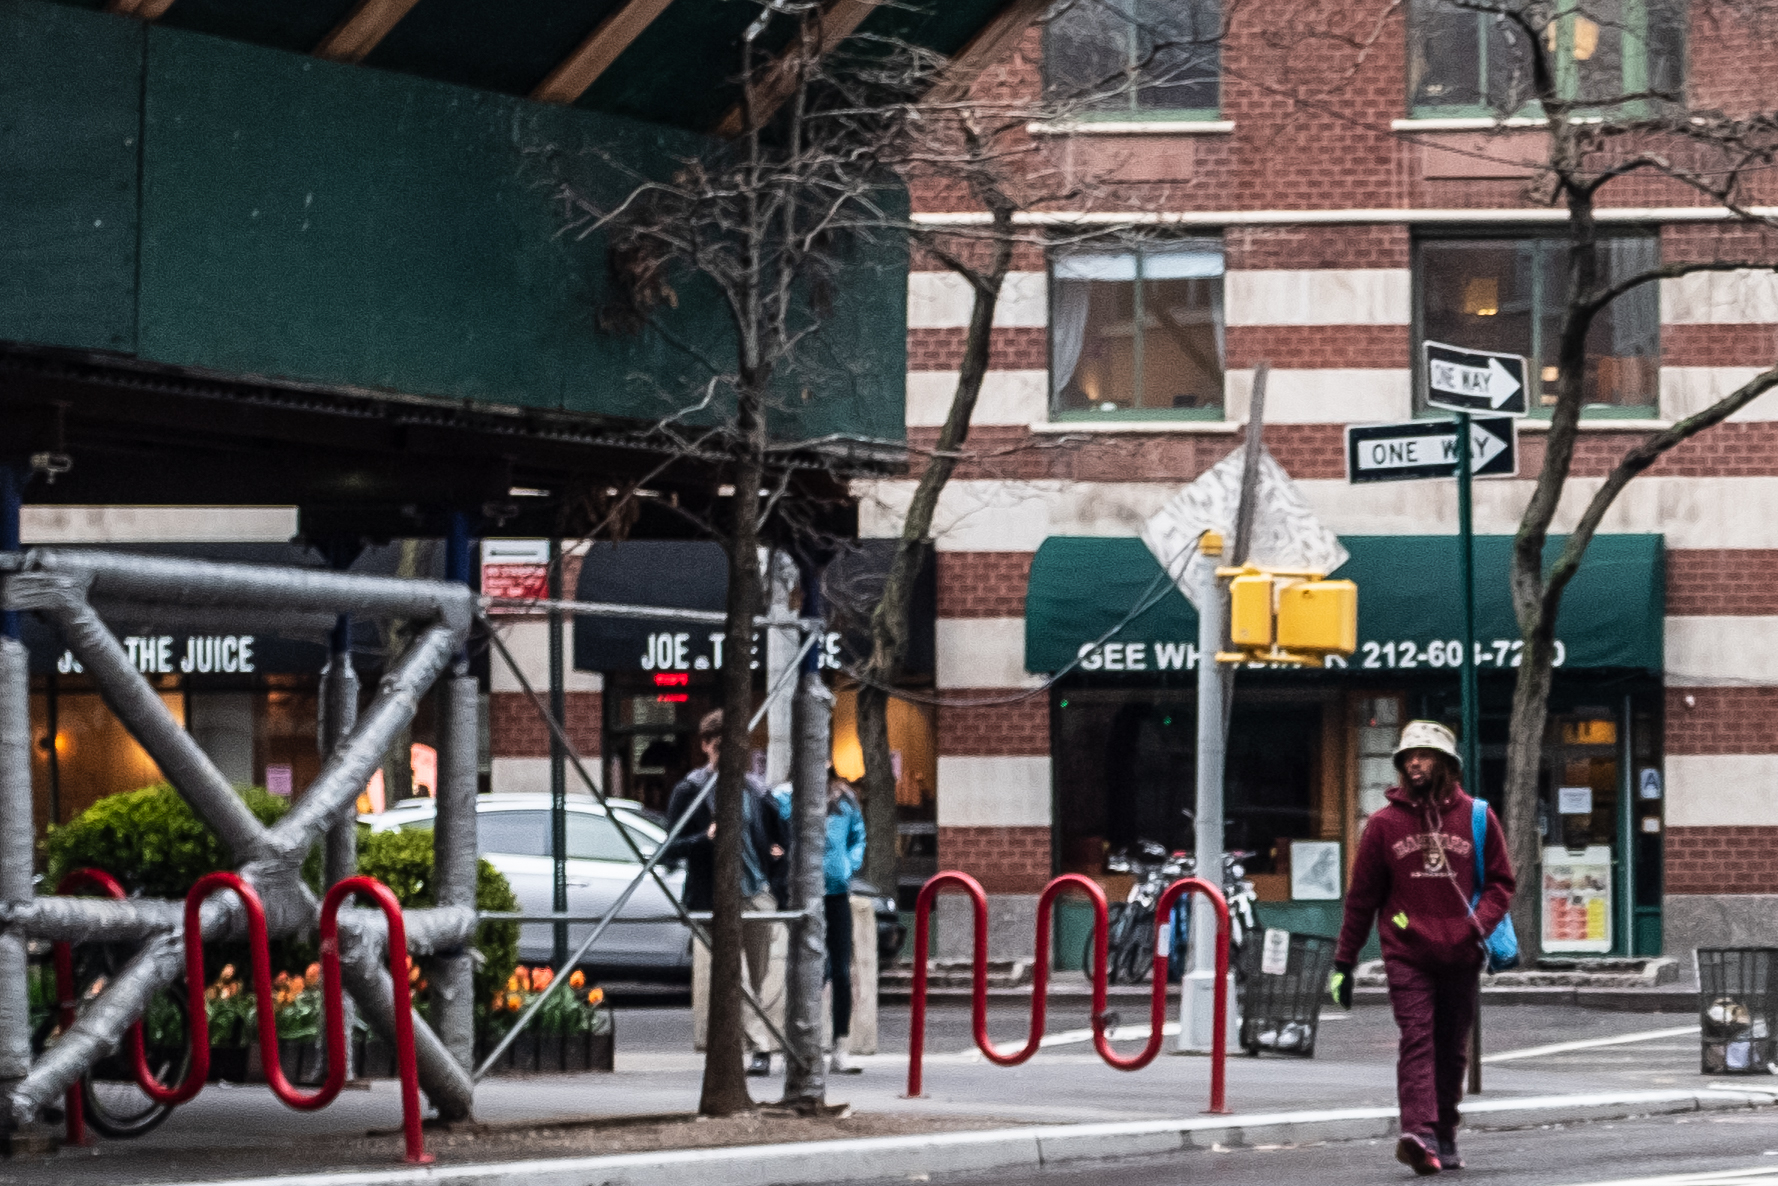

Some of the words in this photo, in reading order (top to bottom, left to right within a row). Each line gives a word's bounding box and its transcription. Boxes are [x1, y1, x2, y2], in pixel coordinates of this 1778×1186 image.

[1371, 441, 1419, 466] ONE
[124, 635, 174, 673] THE
[180, 635, 255, 673] JUICE
[641, 632, 691, 670] JOE
[1079, 641, 1148, 671] GEE
